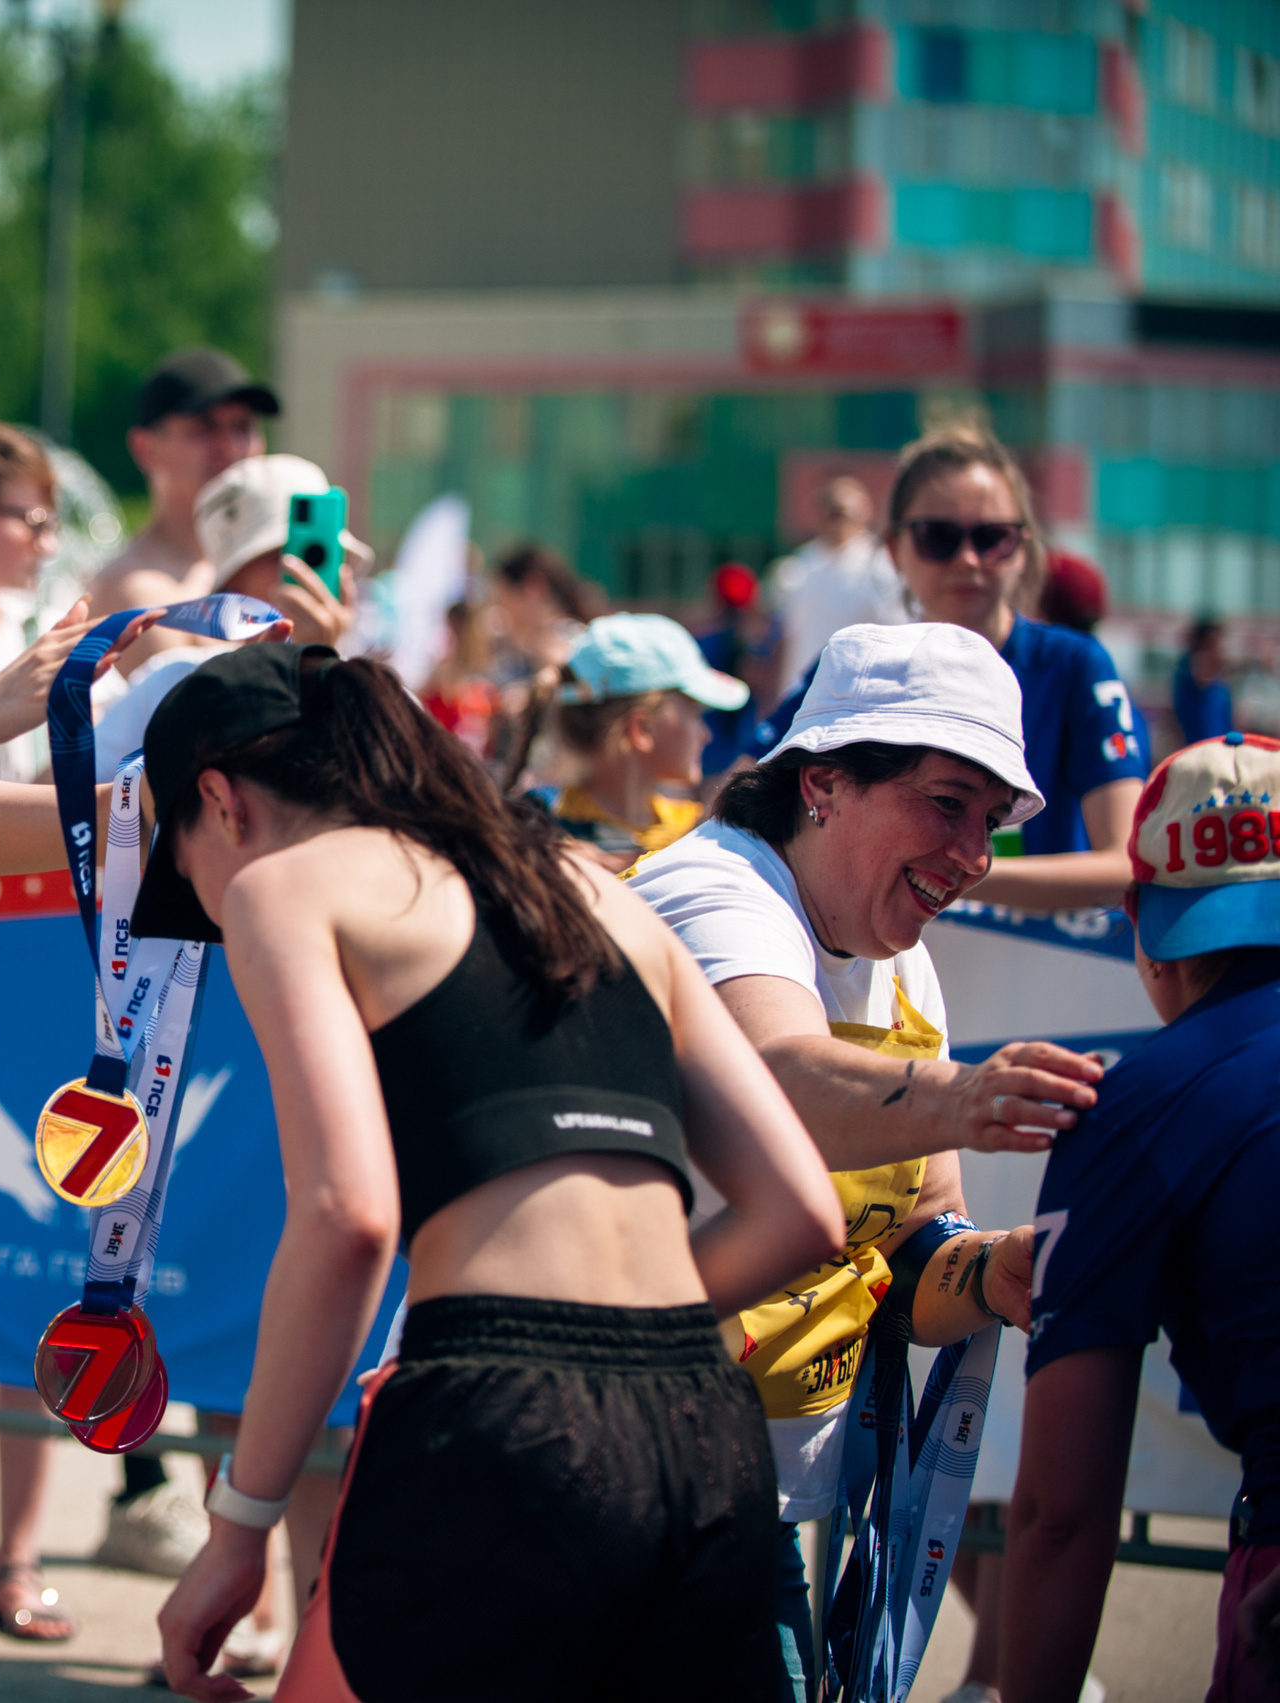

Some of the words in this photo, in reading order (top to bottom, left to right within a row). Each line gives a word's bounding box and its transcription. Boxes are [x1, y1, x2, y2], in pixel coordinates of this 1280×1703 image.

[1092, 679, 1133, 732] 7
[78, 849, 92, 896] ПСБ
[115, 918, 130, 957] ПСБ
[126, 976, 151, 1016] ПСБ
[146, 1079, 166, 1118] ПСБ
[49, 1088, 140, 1199] 7
[47, 1321, 135, 1421] 7
[920, 1561, 939, 1597] ПСБ
